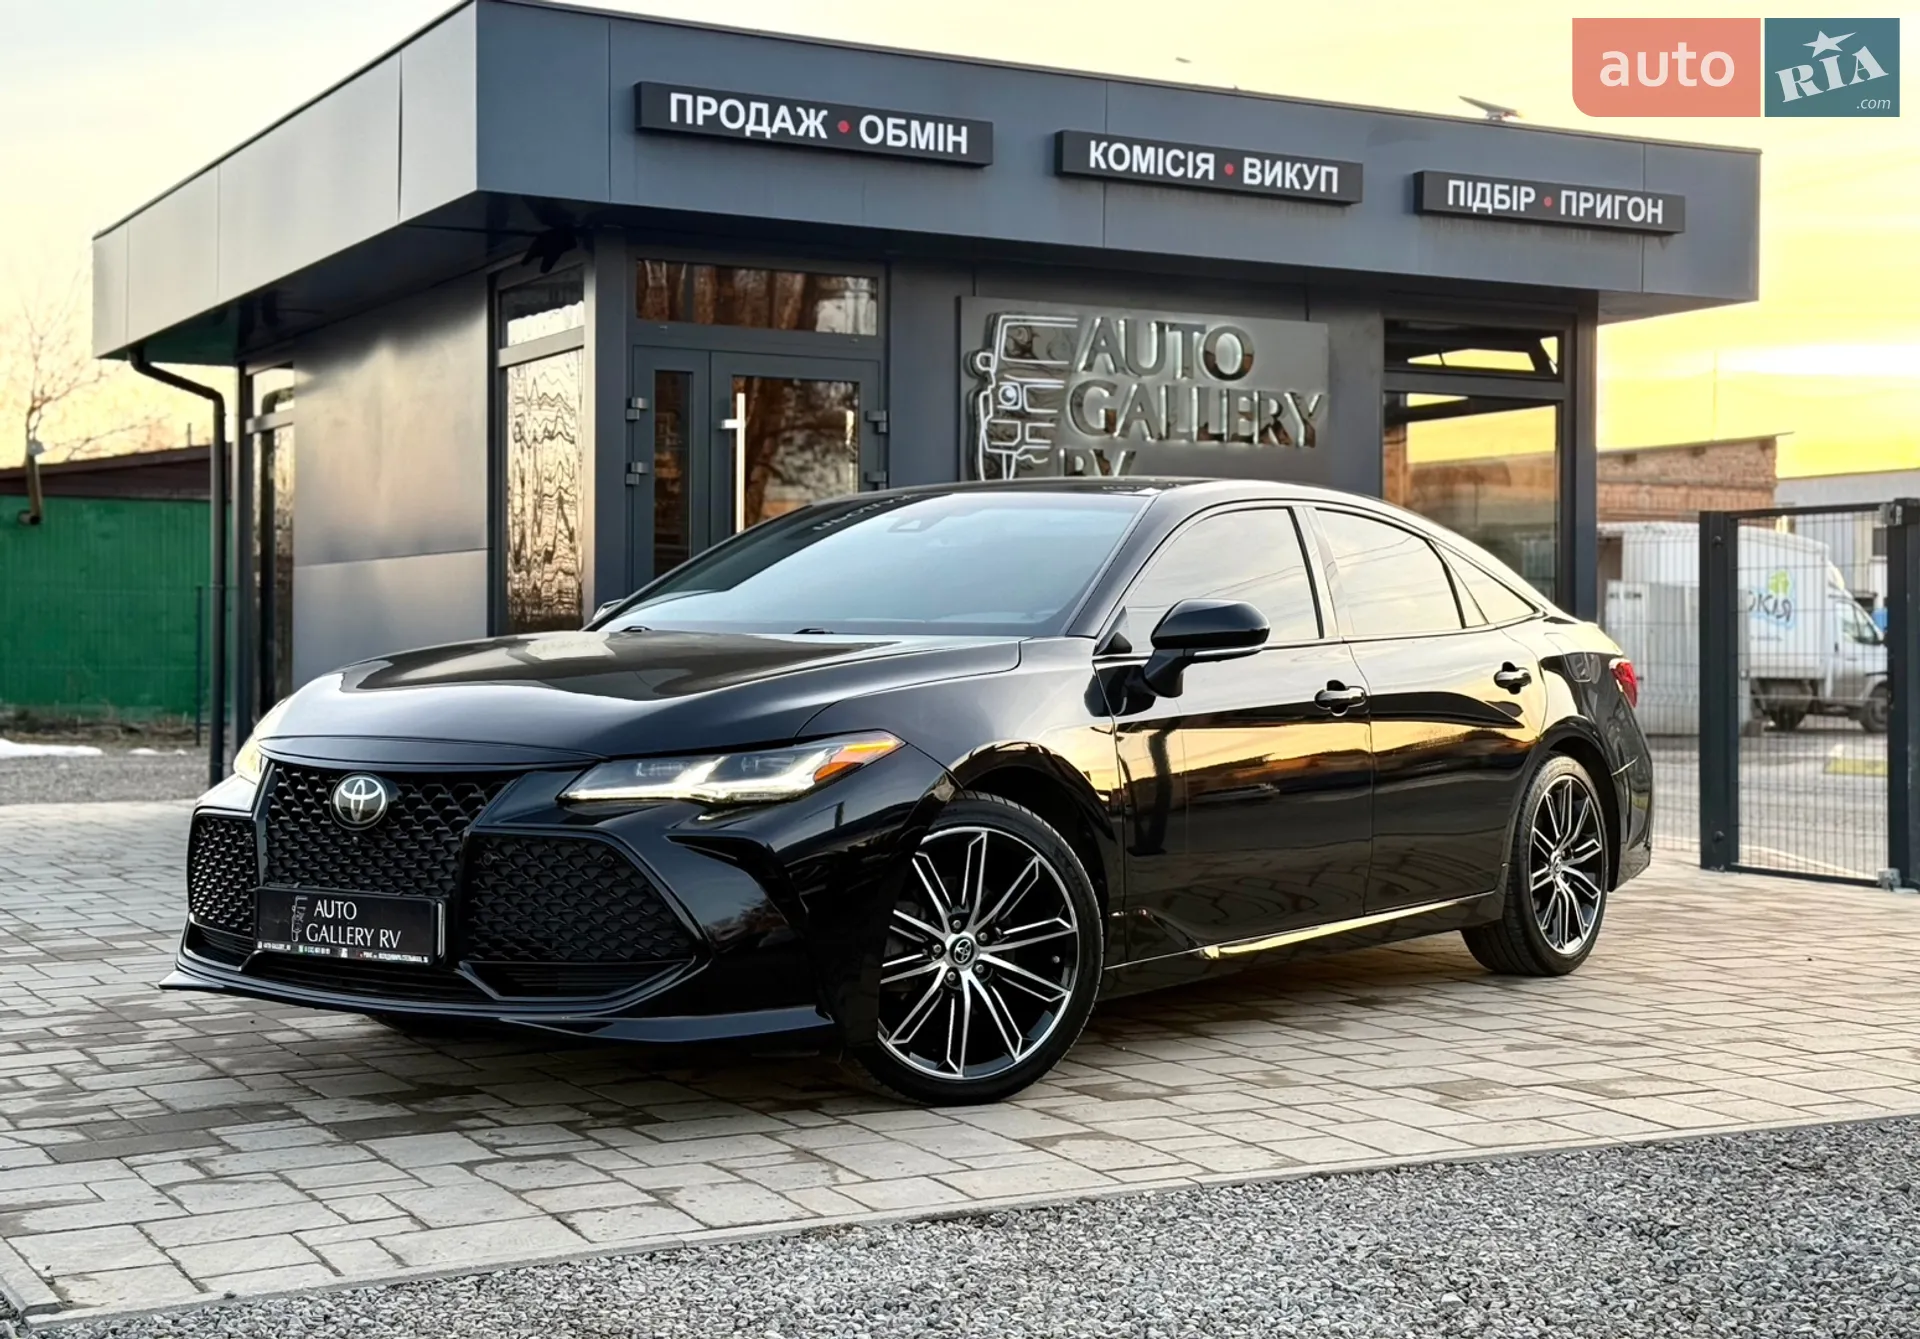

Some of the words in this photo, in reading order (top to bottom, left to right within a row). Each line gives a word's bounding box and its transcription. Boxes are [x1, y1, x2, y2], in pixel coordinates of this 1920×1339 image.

[670, 92, 828, 139] ПРОДАЖ
[859, 115, 967, 154] ОБМІН
[1089, 140, 1215, 180] КОМІСІЯ
[1243, 157, 1338, 193] ВИКУП
[1448, 179, 1536, 214] ПІДБІР
[1560, 190, 1663, 224] ПРИГОН
[1077, 316, 1255, 381] AUTO
[1066, 379, 1327, 448] GALLERY
[306, 923, 375, 947] GALLERY
[379, 928, 402, 949] RV
[314, 899, 357, 920] AUTO
